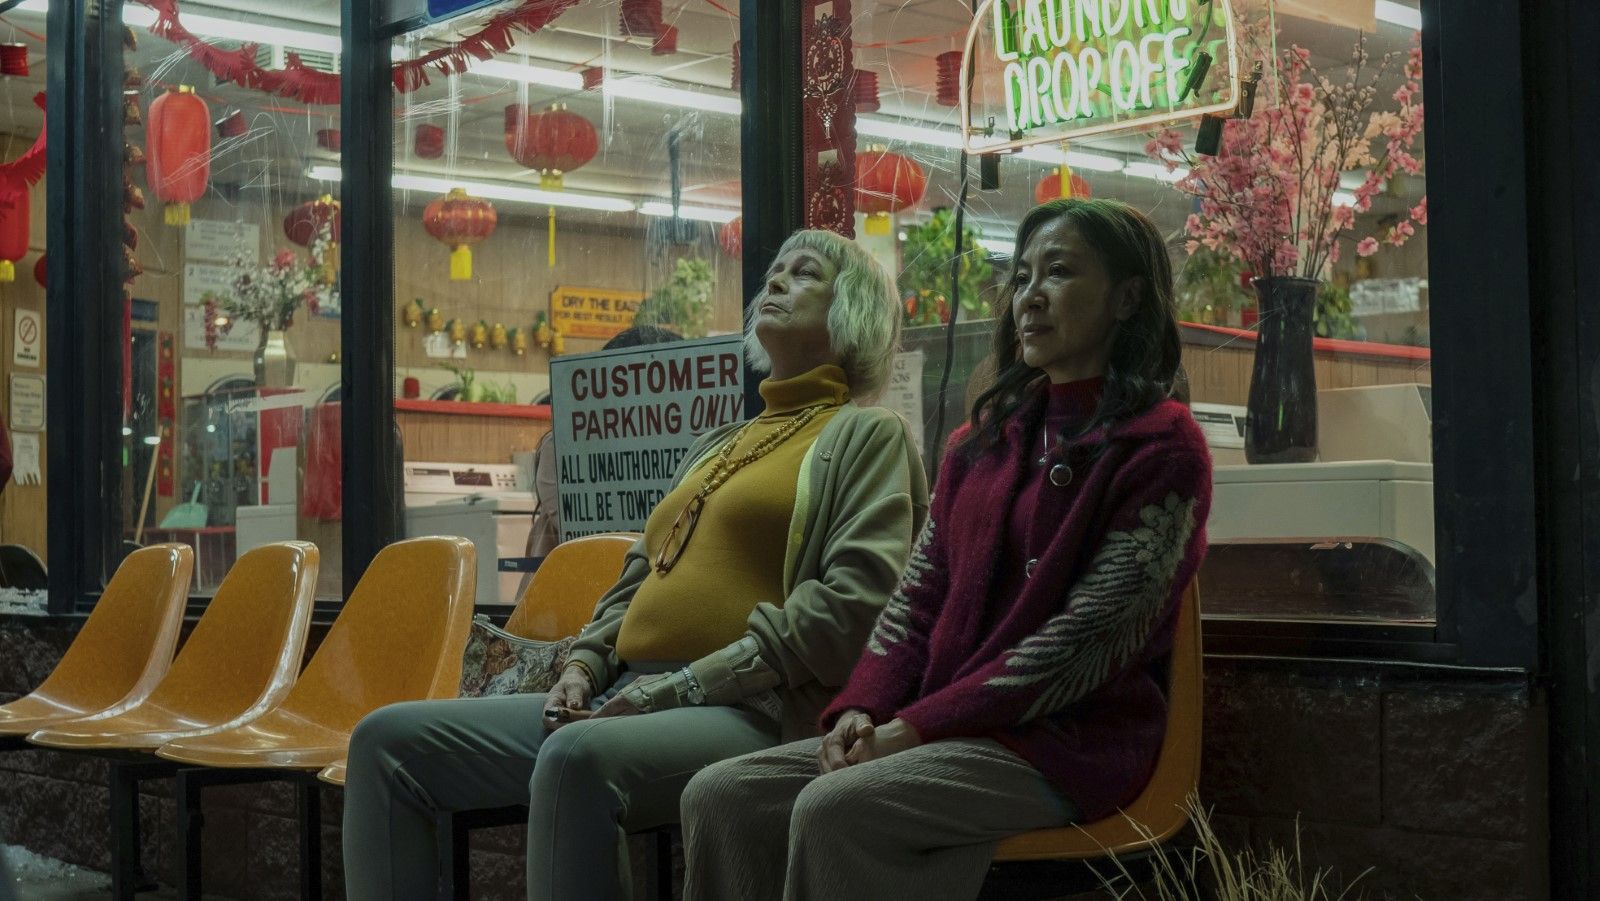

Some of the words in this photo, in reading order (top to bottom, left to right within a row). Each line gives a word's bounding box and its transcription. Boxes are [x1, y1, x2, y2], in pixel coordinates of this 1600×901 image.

[1003, 47, 1101, 132] DROP
[1110, 27, 1192, 110] OFF
[562, 296, 585, 309] DRY
[590, 298, 610, 310] THE
[571, 353, 739, 401] CUSTOMER
[571, 402, 682, 442] PARKING
[689, 393, 744, 431] ONLY
[561, 455, 585, 484] ALL
[562, 493, 593, 522] WILL
[596, 491, 613, 521] BE
